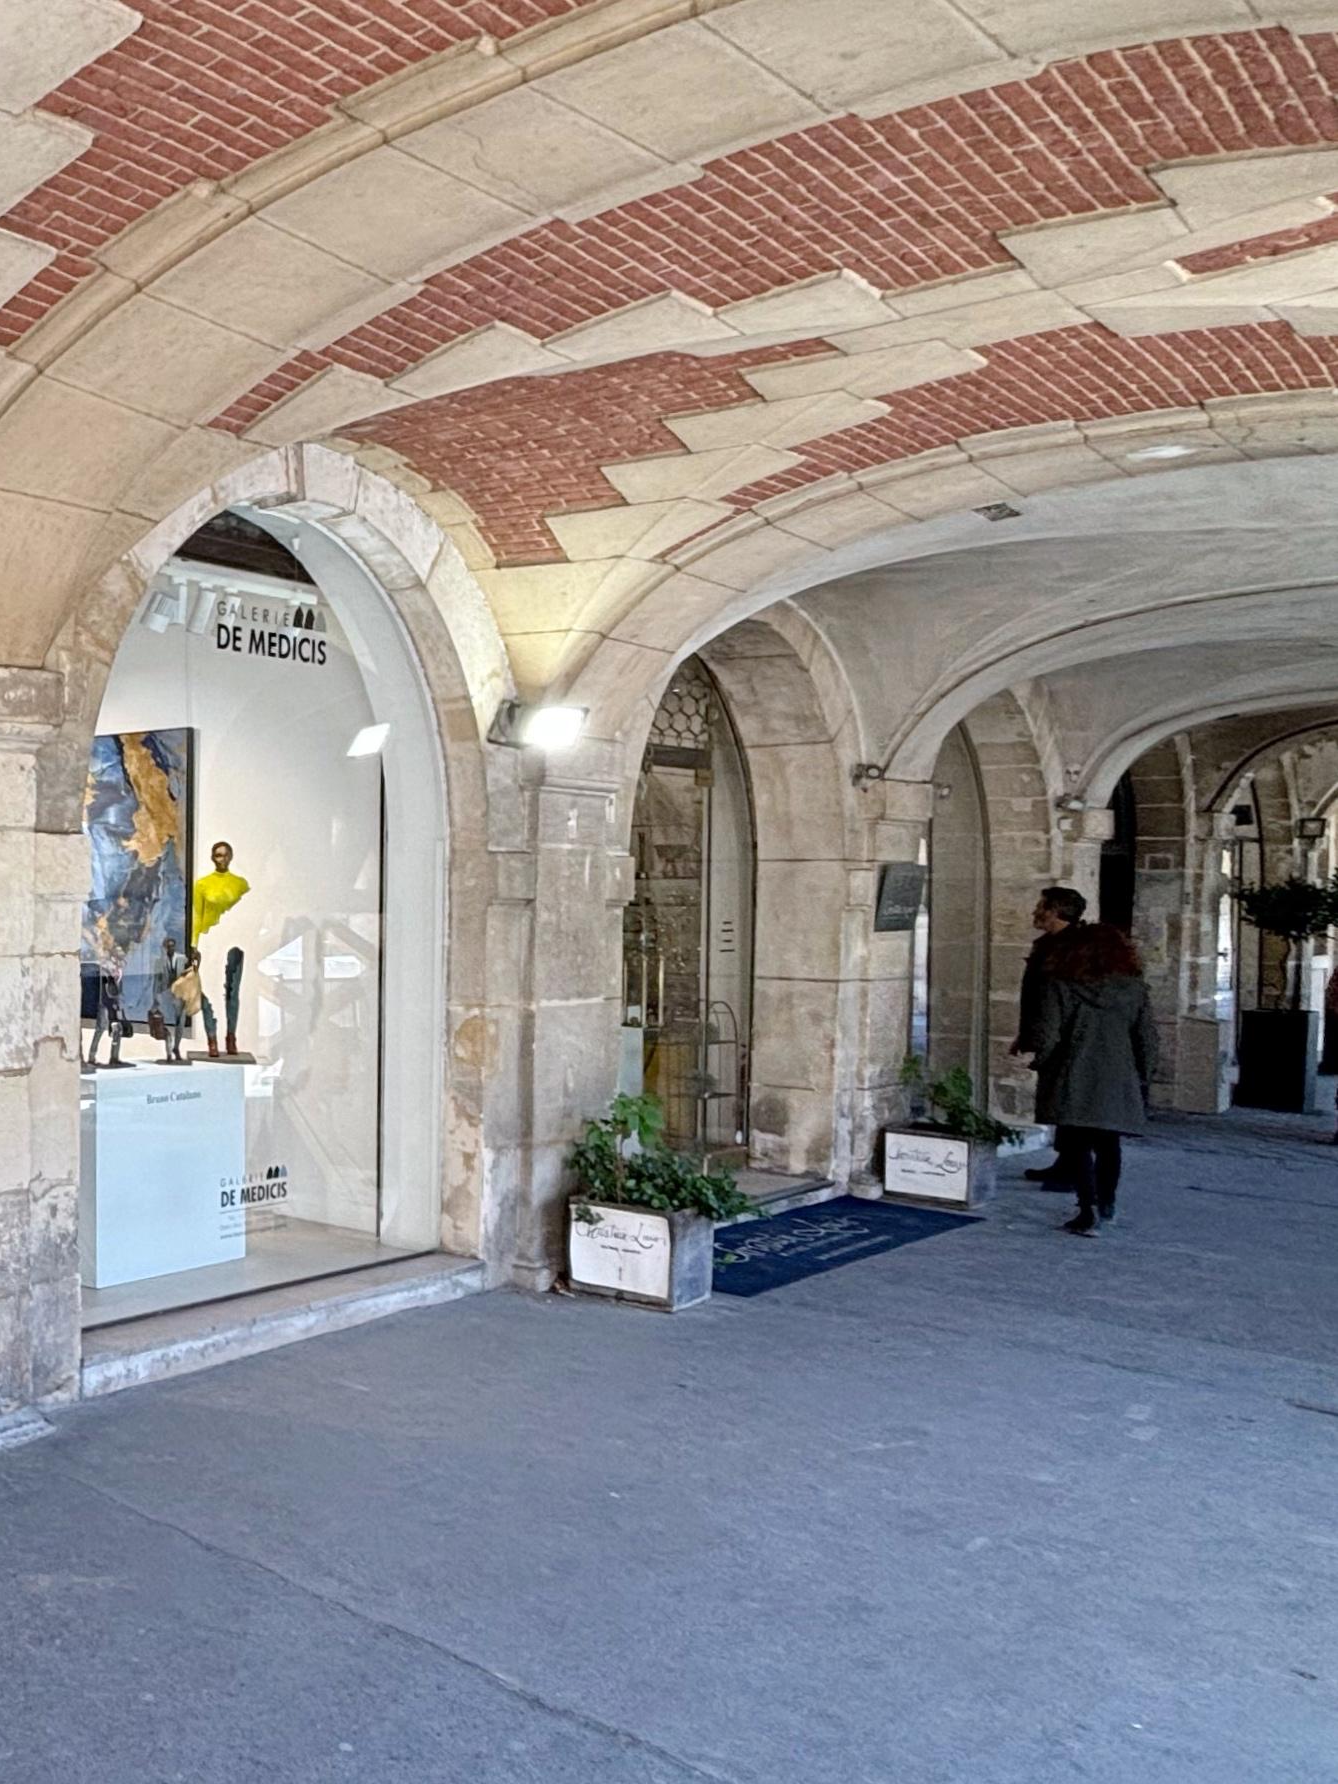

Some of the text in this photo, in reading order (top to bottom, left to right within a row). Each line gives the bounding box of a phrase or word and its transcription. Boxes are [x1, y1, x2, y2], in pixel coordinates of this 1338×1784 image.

[217, 600, 291, 627] GALERIE
[217, 623, 327, 666] DE MEDICIS
[221, 1182, 287, 1208] DE MEDICIS
